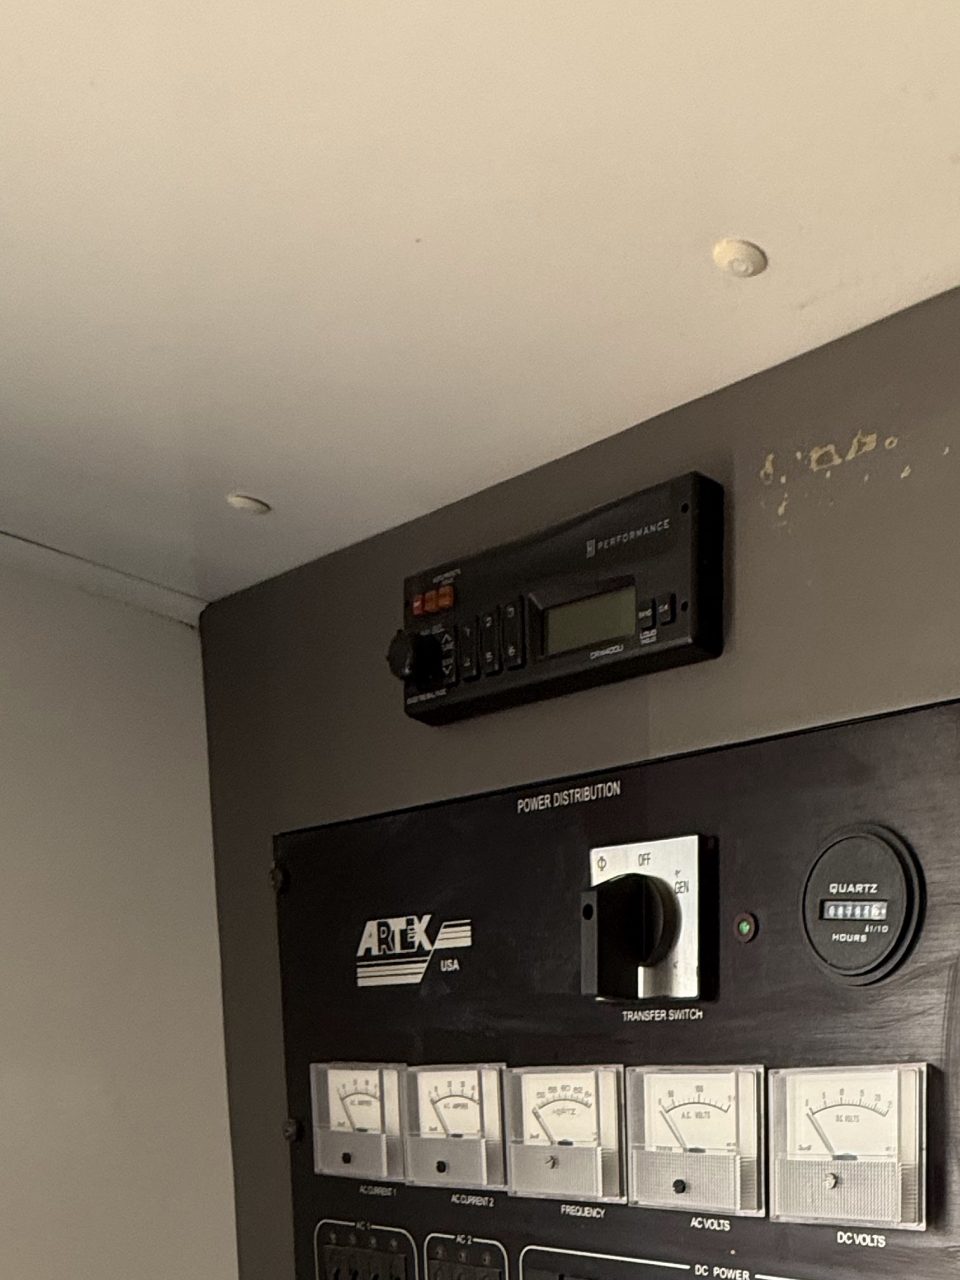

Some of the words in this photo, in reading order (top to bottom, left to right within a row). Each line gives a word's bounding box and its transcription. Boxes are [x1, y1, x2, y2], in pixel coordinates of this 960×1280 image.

[598, 519, 670, 549] PERFORMANCE
[517, 794, 551, 814] POWER
[553, 780, 621, 807] DISTRIBUTION
[638, 852, 651, 866] OFF
[675, 880, 689, 894] GEN
[829, 883, 878, 894] QUARTZ
[832, 933, 867, 942] HOURS
[441, 960, 459, 972] USA
[622, 1009, 667, 1021] TRANSFER
[668, 1008, 703, 1020] SWITCH
[451, 1194, 460, 1204] AC
[460, 1195, 489, 1206] CURRENT
[489, 1198, 495, 1207] 2
[560, 1204, 606, 1218] FREQUENCY
[690, 1217, 703, 1228] AC
[703, 1218, 731, 1231] VOLTS
[837, 1231, 853, 1244] DC
[853, 1233, 886, 1248] VOLTS
[694, 1264, 709, 1276] DC
